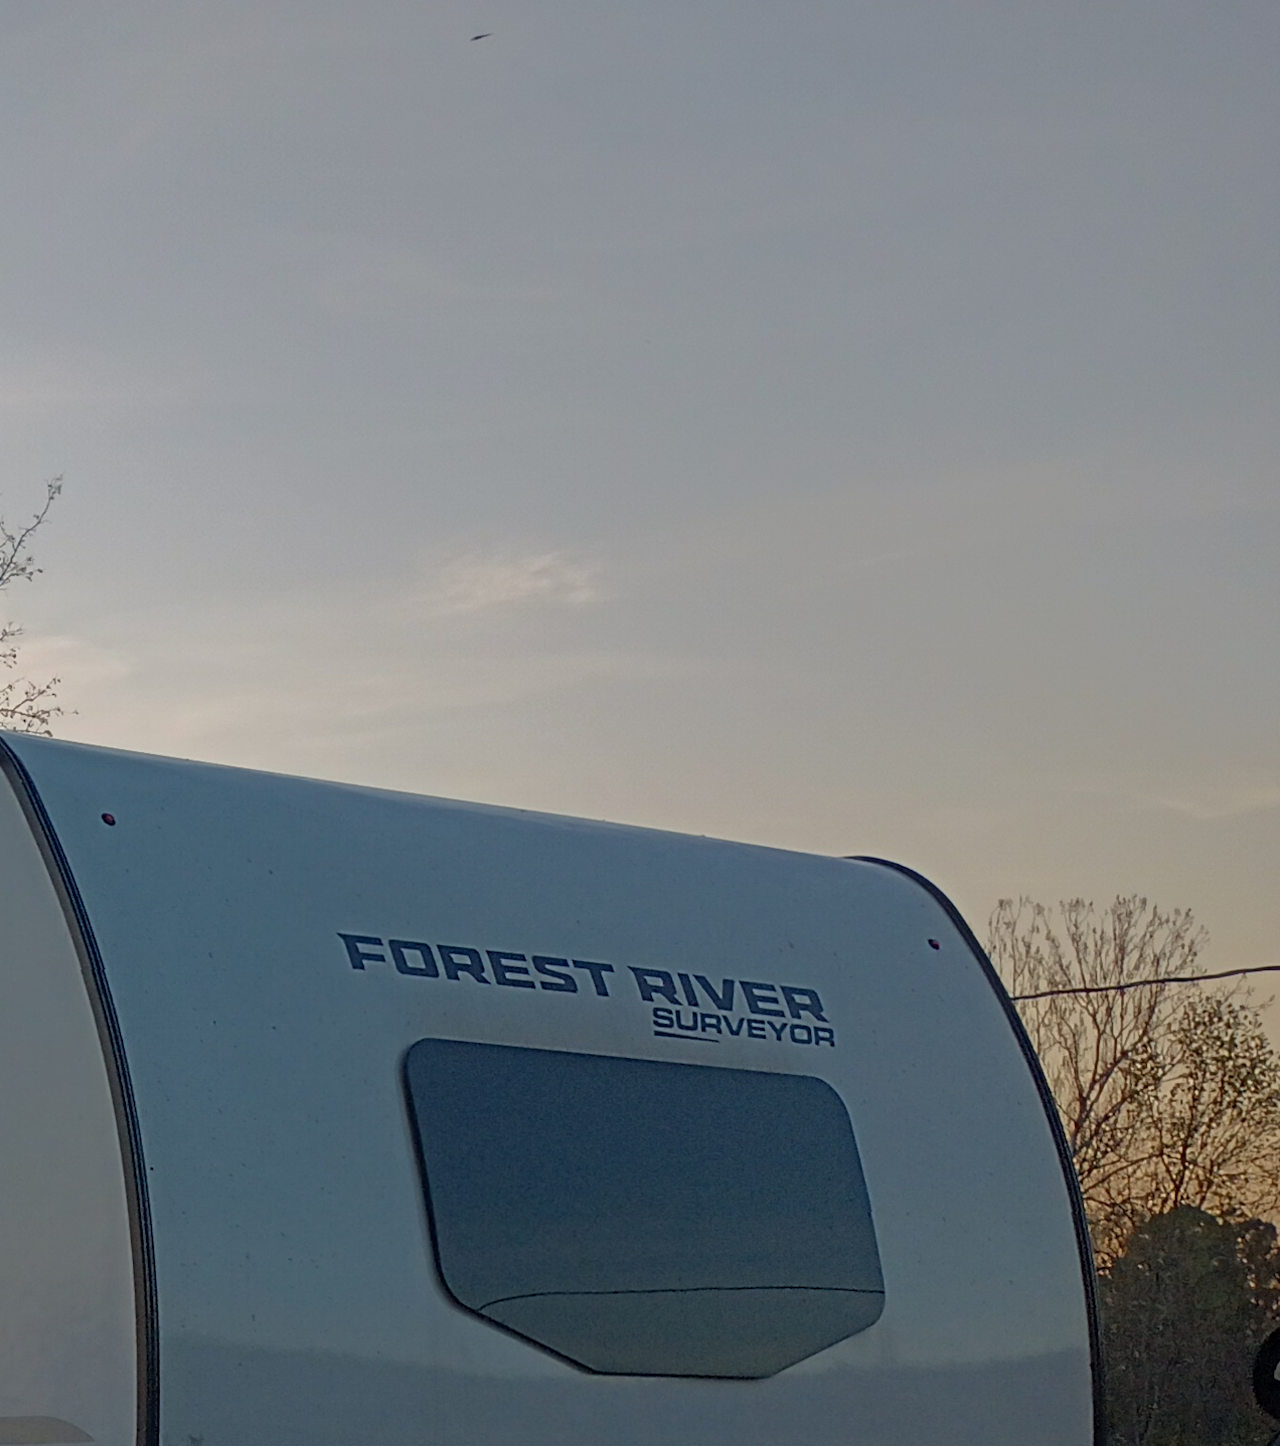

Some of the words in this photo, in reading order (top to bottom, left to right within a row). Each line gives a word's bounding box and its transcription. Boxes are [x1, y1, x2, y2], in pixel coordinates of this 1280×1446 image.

[336, 932, 615, 997] FOREST
[628, 965, 830, 1023] RIVER
[652, 1006, 836, 1048] SURVEYOR
